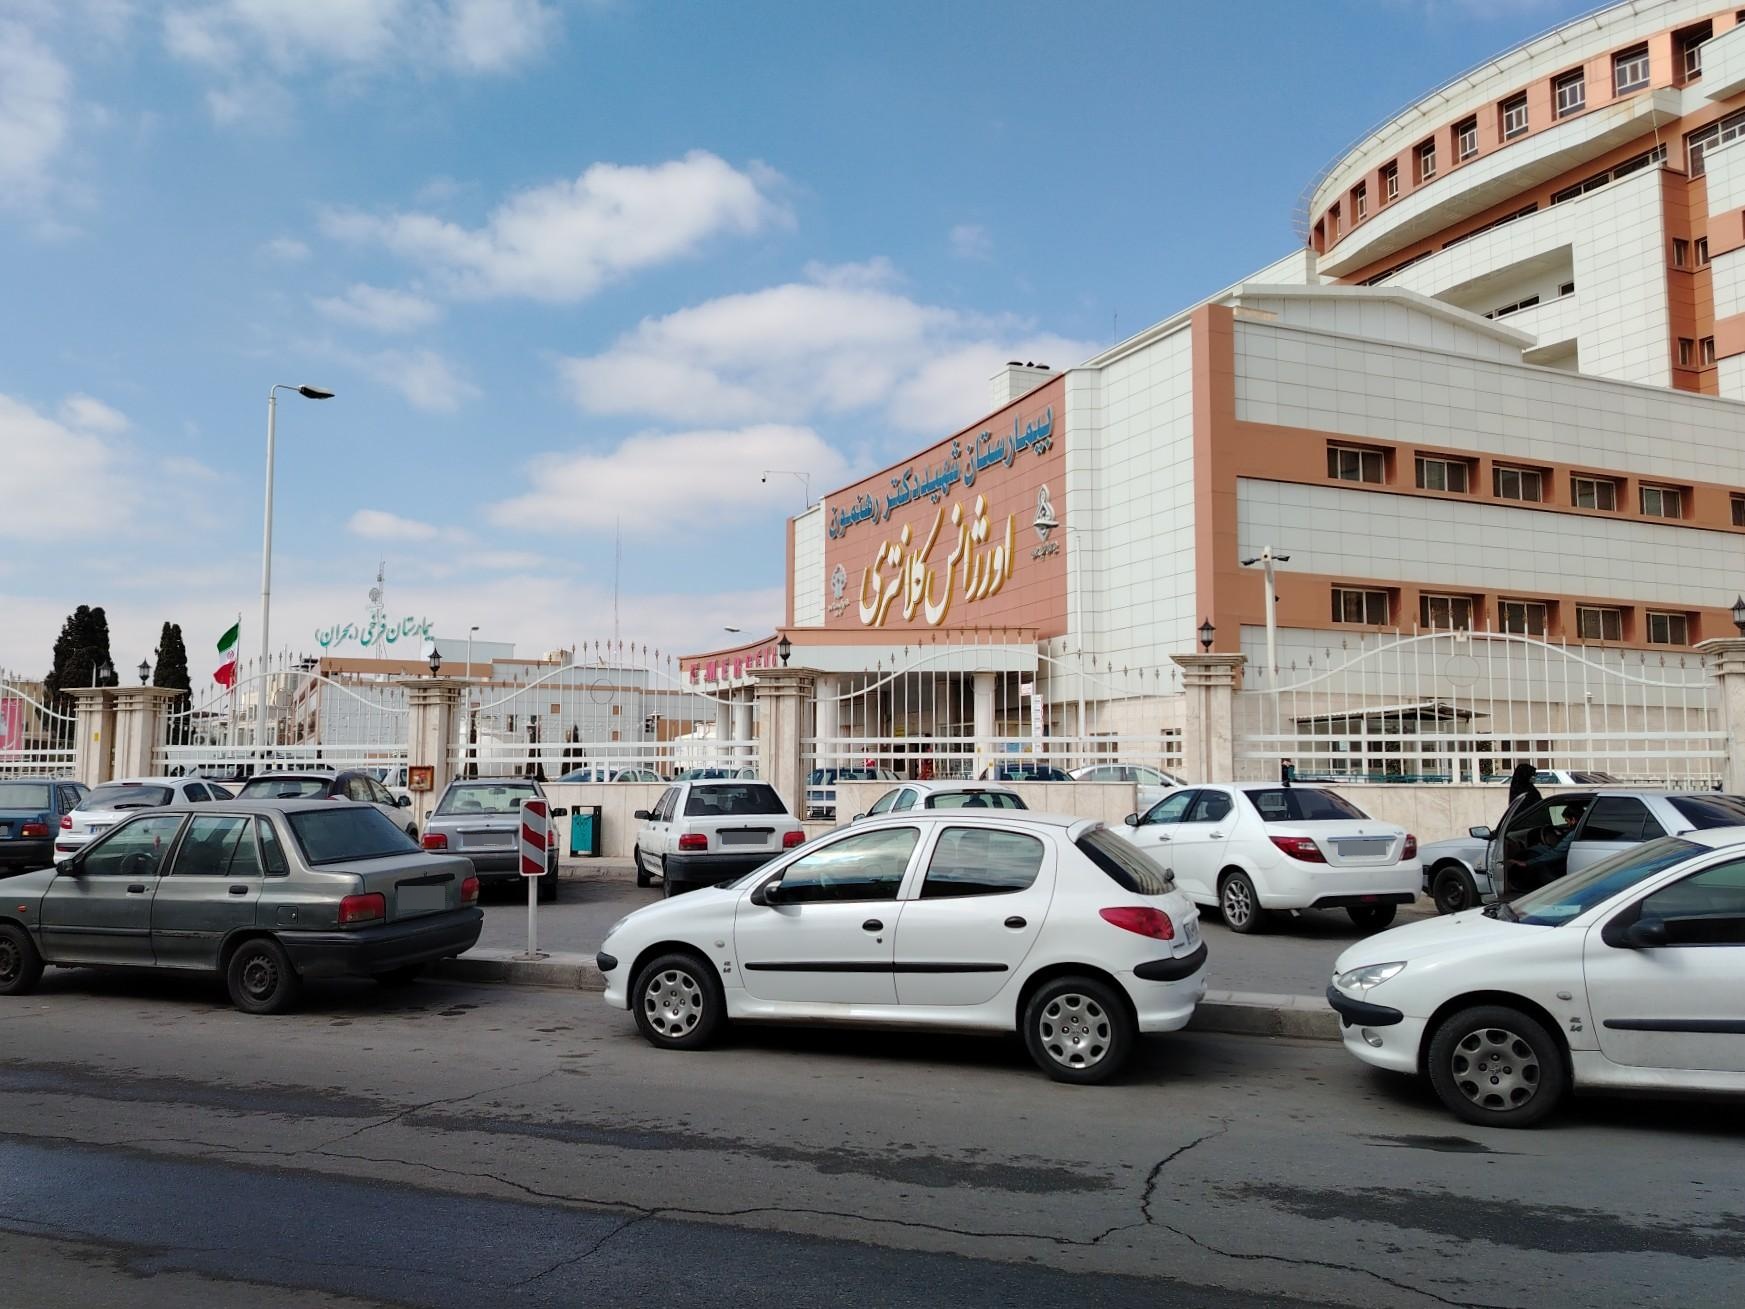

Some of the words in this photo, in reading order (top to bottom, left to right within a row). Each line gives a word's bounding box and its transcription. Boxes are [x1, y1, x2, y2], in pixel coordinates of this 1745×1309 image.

[920, 439, 961, 505] شهید
[963, 405, 1054, 489] بیمارستان
[829, 492, 880, 539] رهنمون
[882, 467, 921, 521] دکتر
[859, 506, 945, 628] کلانتری
[924, 494, 1016, 626] اورژانس
[385, 616, 435, 644] بیمارستان
